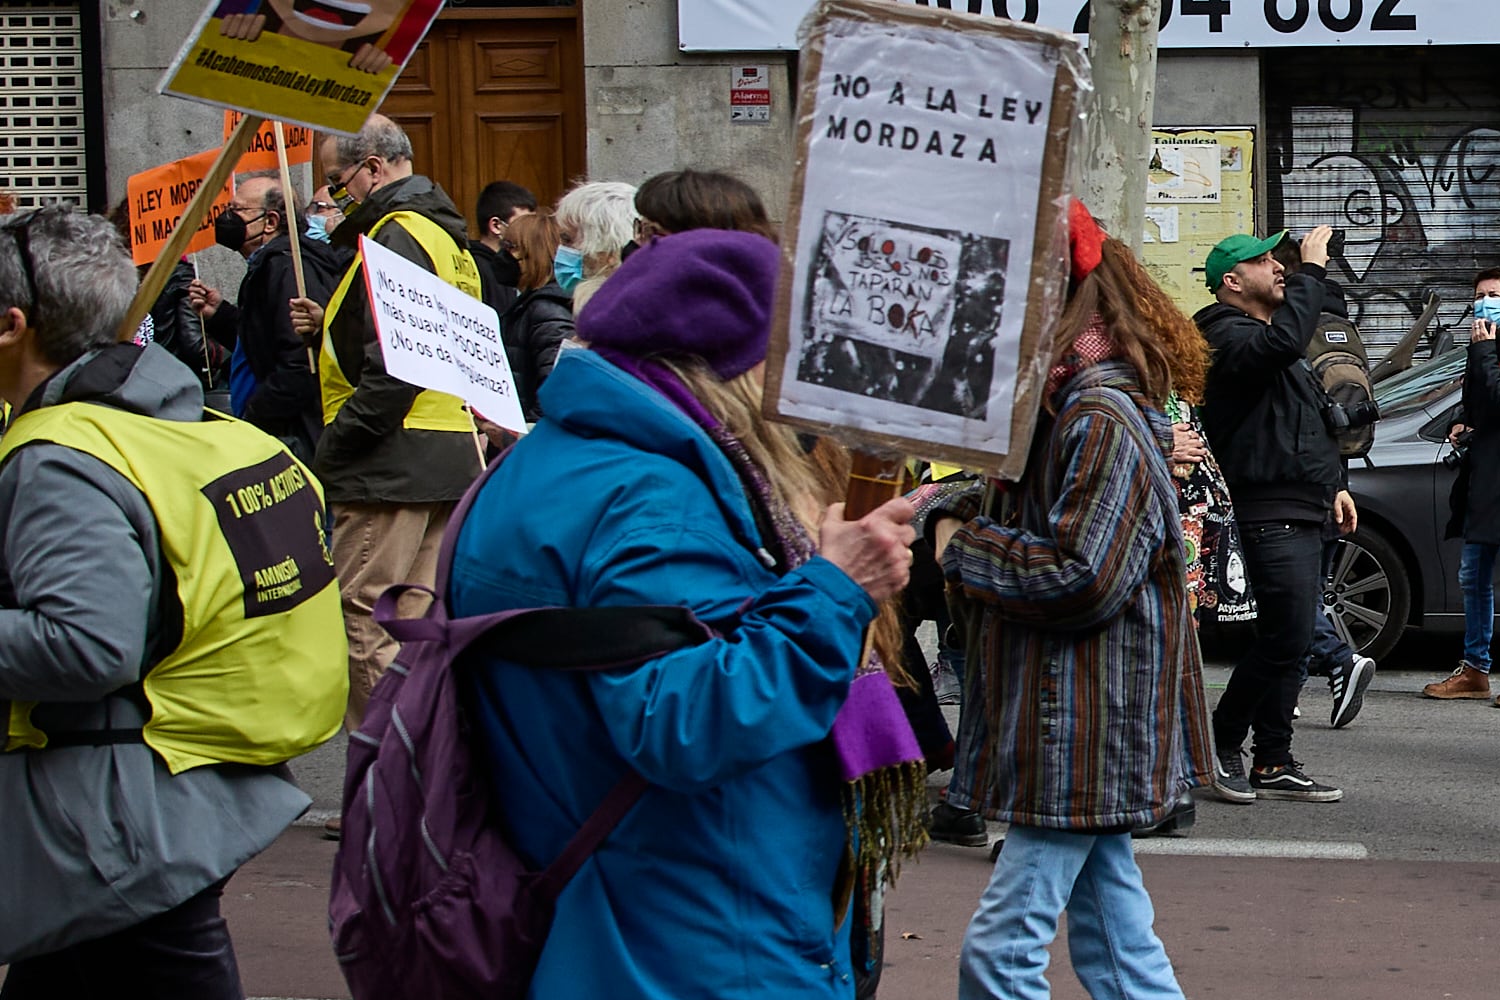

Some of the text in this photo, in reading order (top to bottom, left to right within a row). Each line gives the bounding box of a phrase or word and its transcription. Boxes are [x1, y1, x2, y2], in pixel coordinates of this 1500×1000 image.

[733, 91, 769, 100] Alarma
[832, 73, 1043, 125] NO A LA LEY
[826, 115, 997, 163] MORDAZA
[134, 224, 147, 245] NI
[853, 253, 951, 287] BESOS NOS
[908, 243, 949, 270] LOS
[398, 284, 405, 298] a
[408, 287, 433, 309] otra
[434, 294, 450, 322] ley
[451, 309, 498, 344] mordaza
[829, 293, 937, 340] LA BOKA
[390, 328, 413, 351] ¿No
[416, 341, 433, 358] os
[436, 344, 453, 363] da
